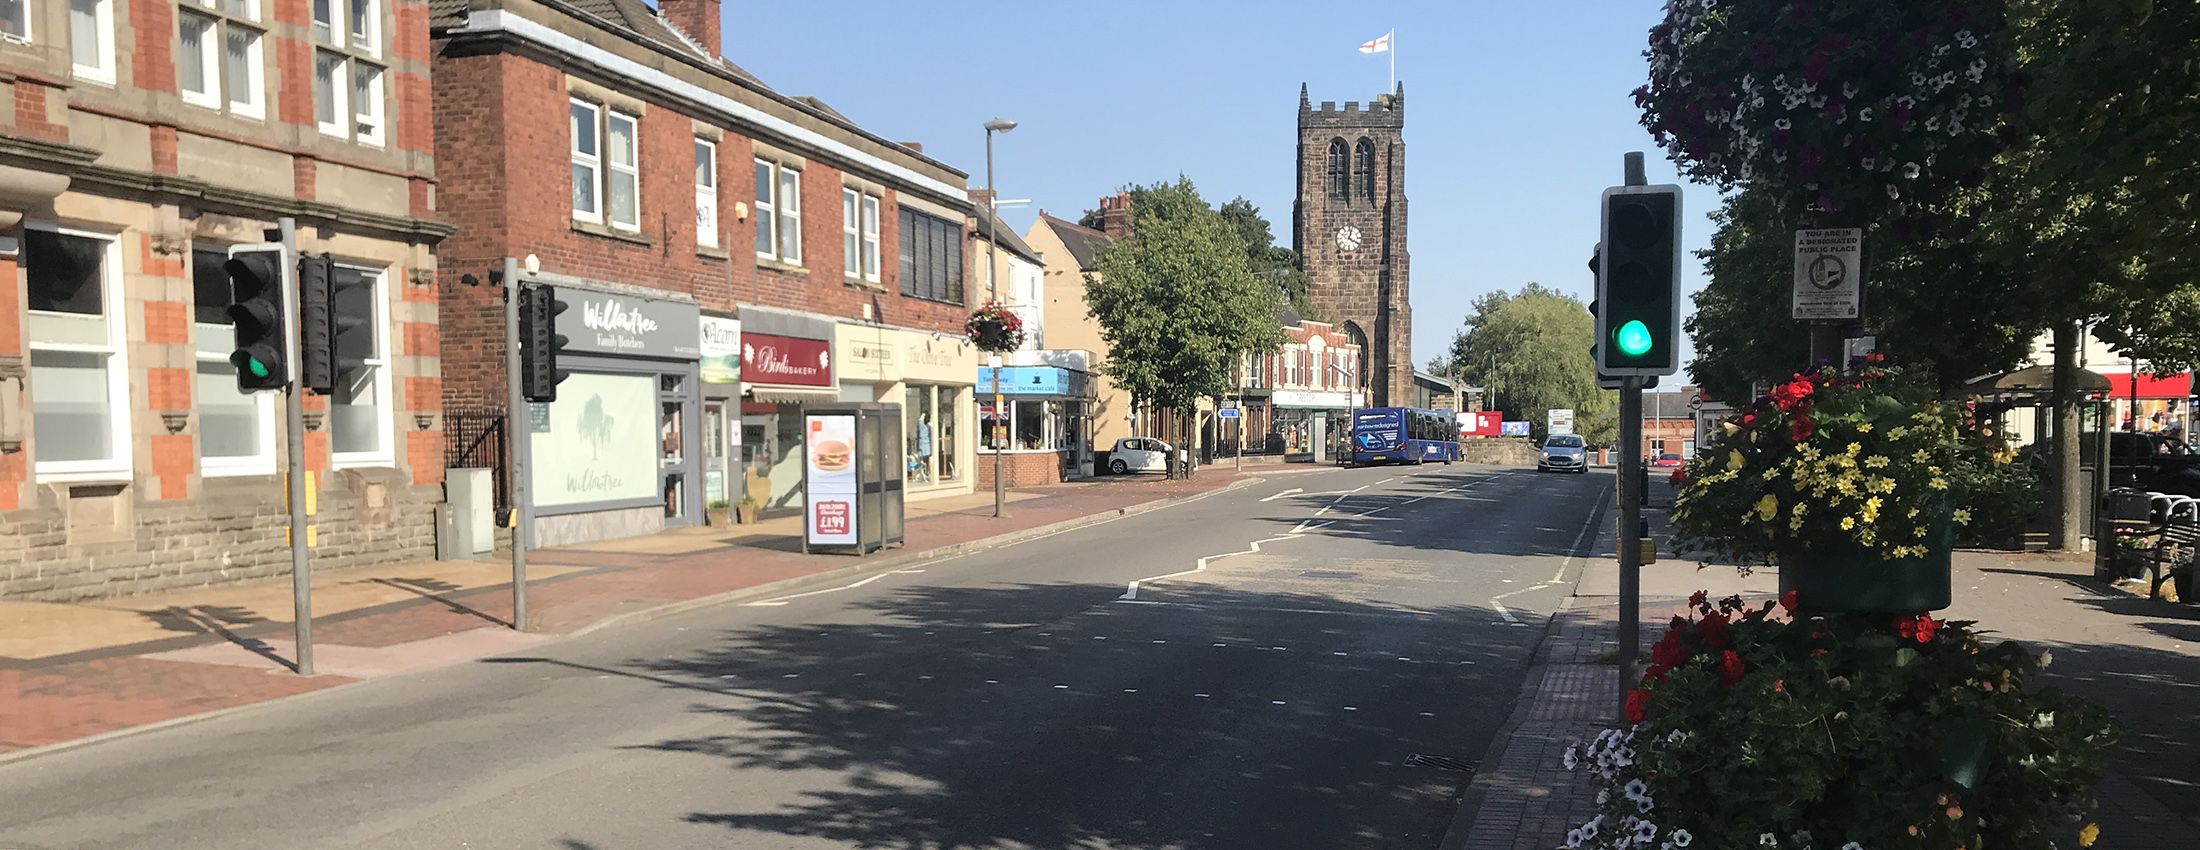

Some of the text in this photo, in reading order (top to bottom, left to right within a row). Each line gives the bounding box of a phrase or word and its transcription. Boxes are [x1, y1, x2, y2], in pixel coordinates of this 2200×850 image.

[583, 298, 658, 335] Willowtree
[852, 346, 871, 358] SALN
[788, 366, 818, 375] BAKERY
[566, 468, 624, 492] Willowtree
